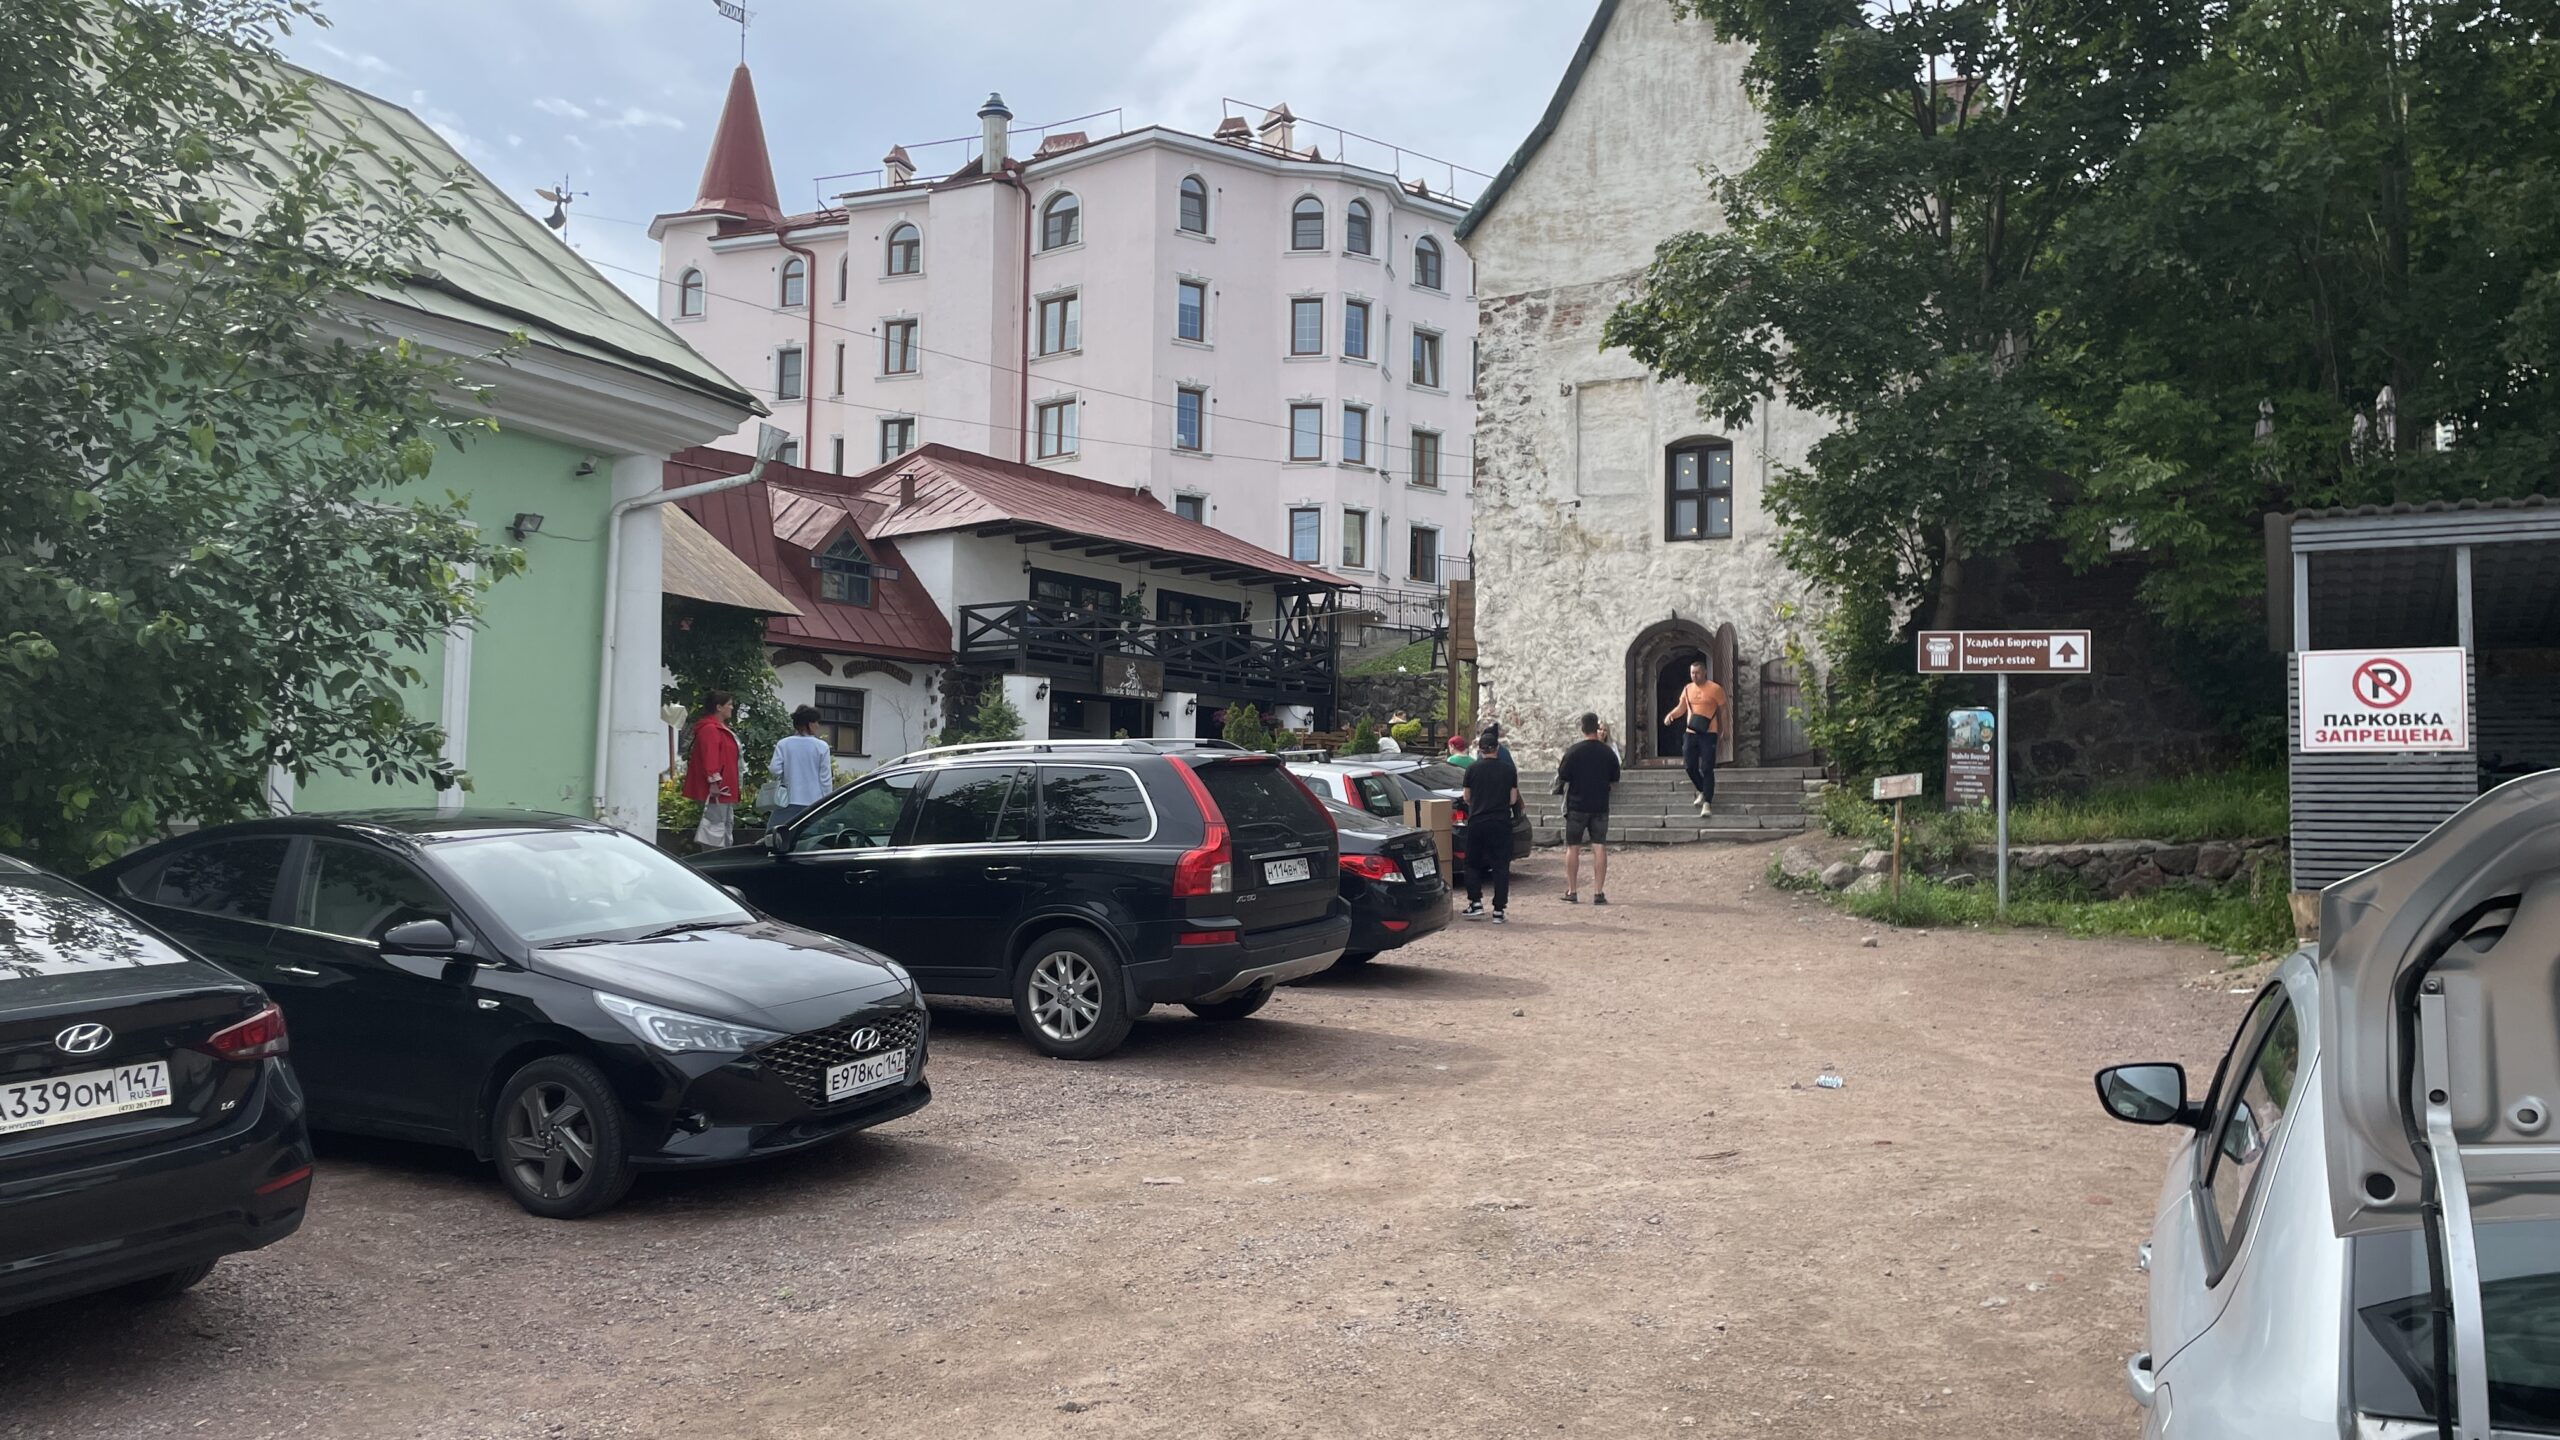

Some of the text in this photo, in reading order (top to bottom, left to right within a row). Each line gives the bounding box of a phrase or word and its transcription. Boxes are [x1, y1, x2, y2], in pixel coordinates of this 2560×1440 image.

[1966, 637, 2048, 649] Усадьба Бюргера
[1966, 655, 2035, 667] Burger's estate
[1105, 686, 1124, 696] black
[2323, 713, 2444, 727] ПАРКОВКА
[2315, 728, 2453, 744] ЗАПРЕЩЕНА
[832, 1051, 903, 1091] Е978КС 147
[119, 1065, 160, 1091] 147
[129, 1090, 151, 1100] RUS
[8, 1119, 45, 1131] HYUNDAI
